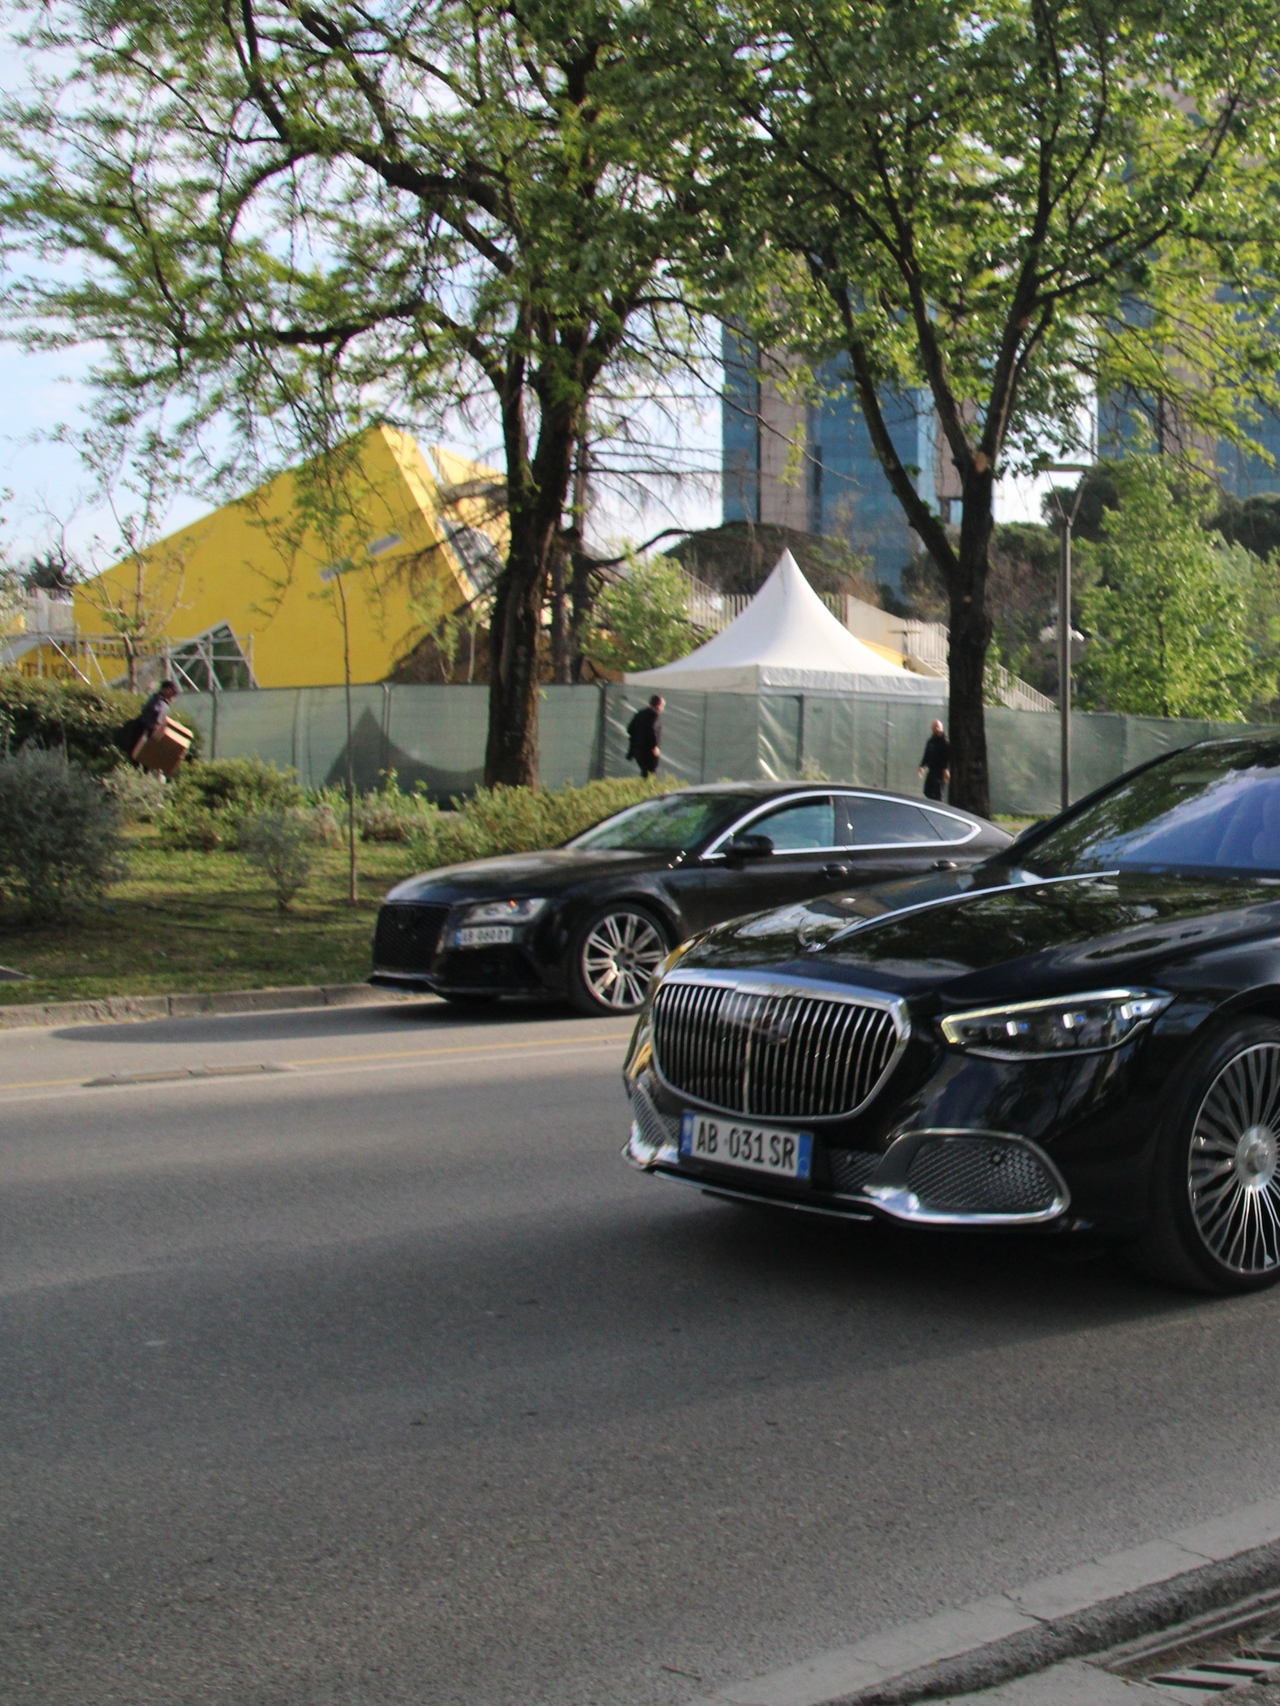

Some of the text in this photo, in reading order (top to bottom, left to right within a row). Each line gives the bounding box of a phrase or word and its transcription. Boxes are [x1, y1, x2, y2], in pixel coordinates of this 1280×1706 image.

[696, 1121, 796, 1171] AB 031 SR
